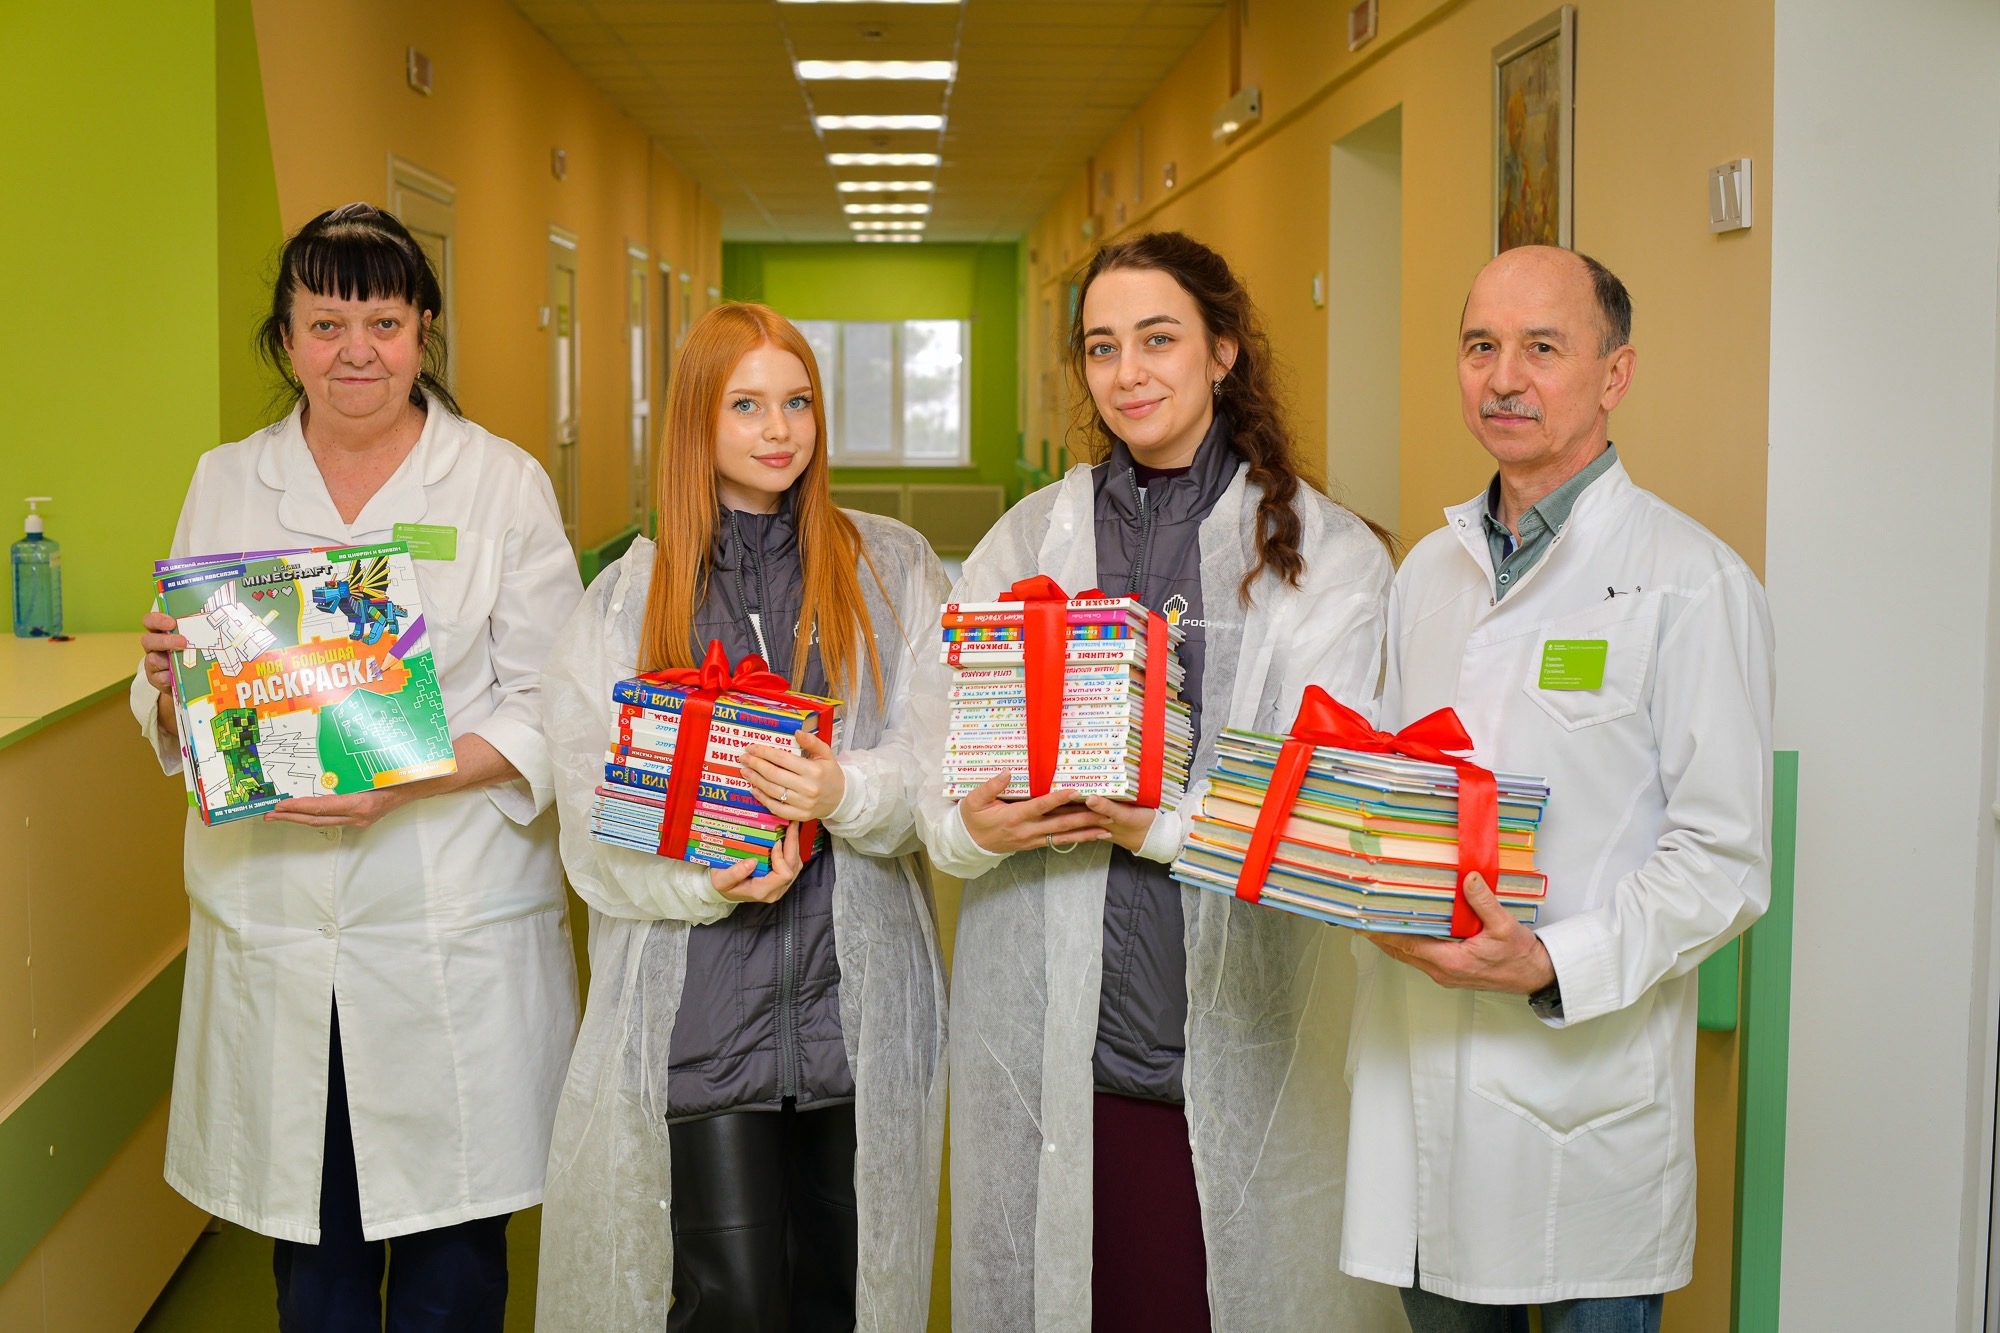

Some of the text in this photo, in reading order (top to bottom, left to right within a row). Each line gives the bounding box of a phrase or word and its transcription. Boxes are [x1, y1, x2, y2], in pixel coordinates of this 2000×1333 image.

[204, 570, 239, 580] ПОДСКАЗКЕ
[242, 565, 333, 587] MINECRAFT
[255, 646, 356, 677] МОЯ БОЛЬШАЯ
[235, 655, 384, 708] РАСКРАСКА
[622, 689, 633, 700] 4
[710, 724, 730, 734] ГОСТ
[733, 728, 739, 736] В
[742, 730, 771, 742] ХОДИТ
[775, 736, 792, 746] КТО
[631, 750, 652, 759] сказки
[643, 762, 664, 771] класс
[613, 769, 624, 780] 3
[224, 806, 247, 814] ТОЧКАМ
[254, 798, 281, 807] ЗНАЧКАМ
[691, 857, 710, 866] Космос
